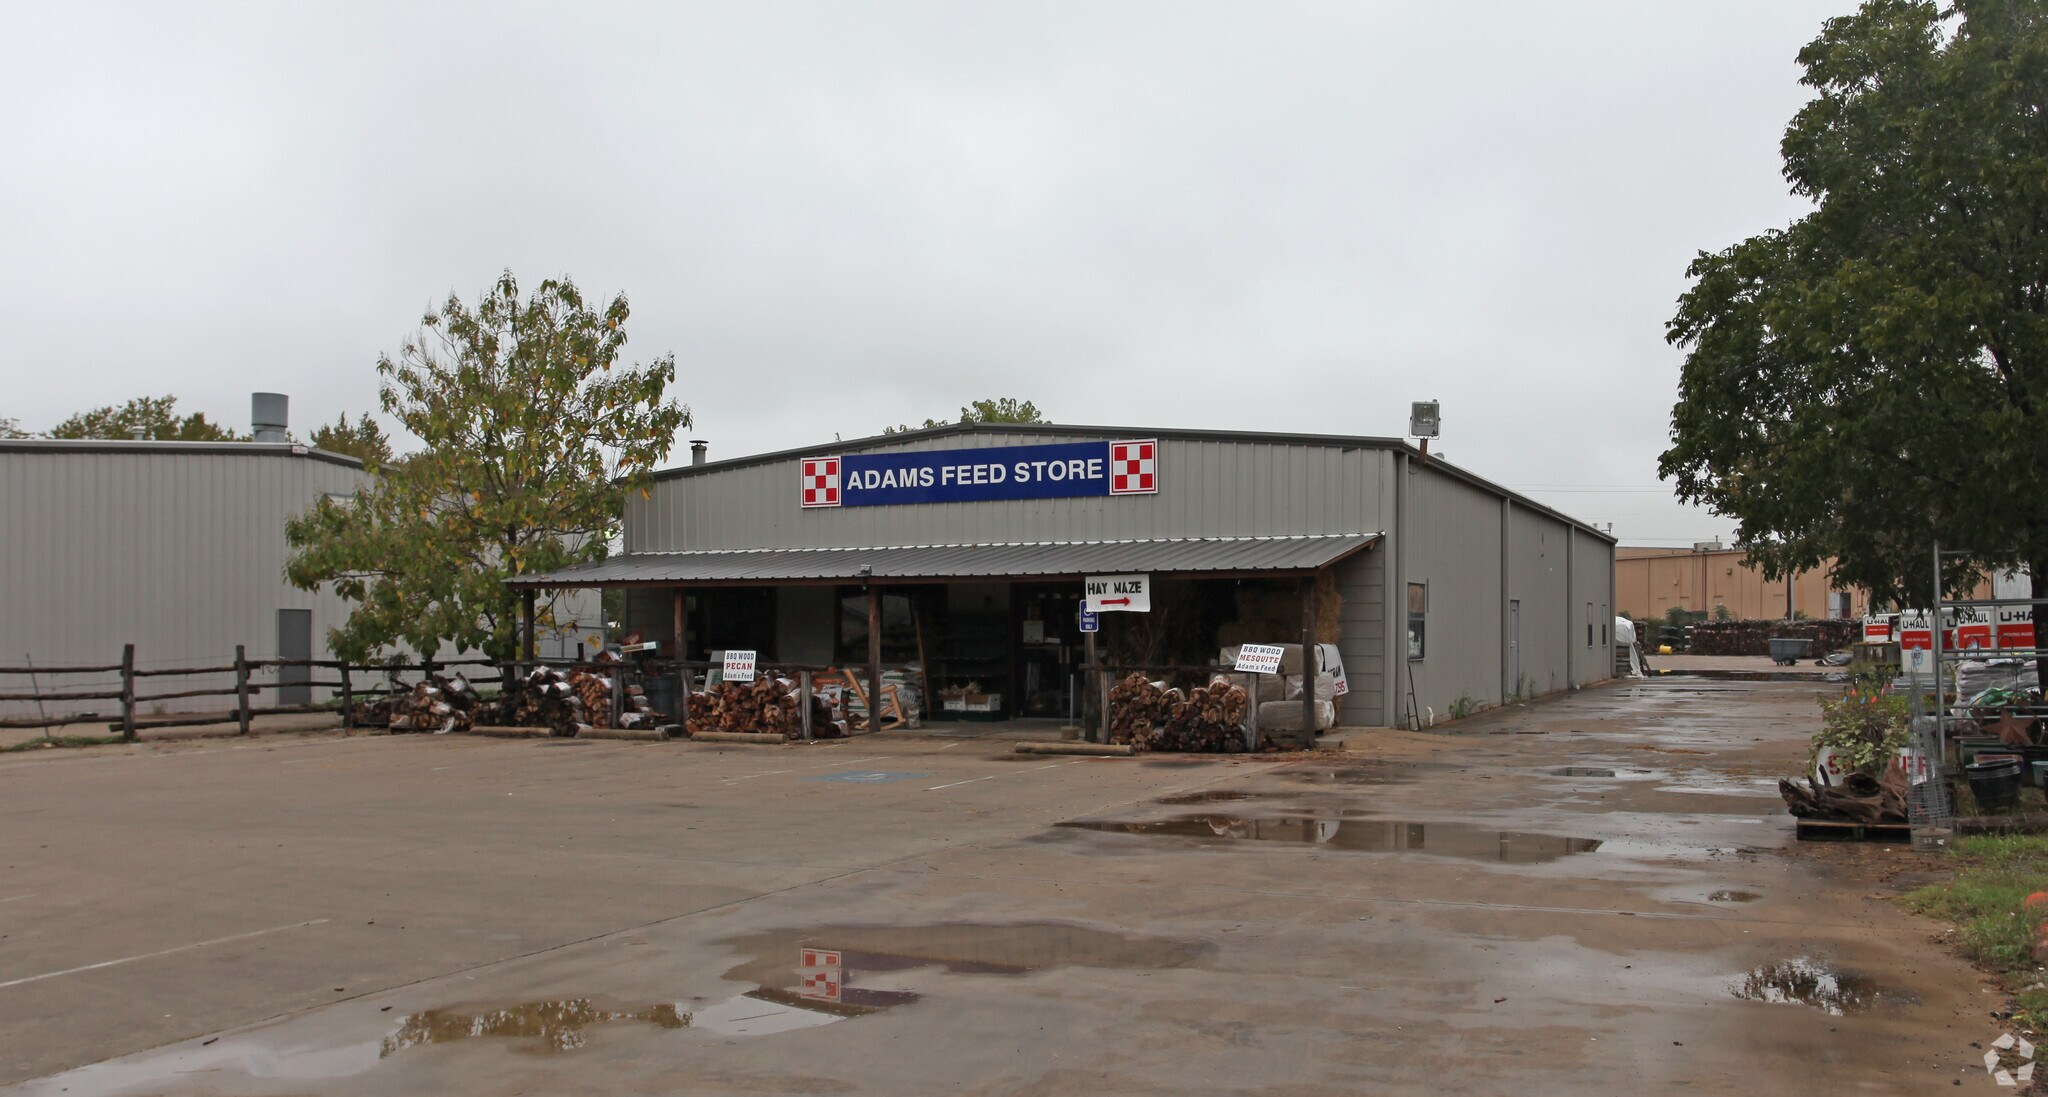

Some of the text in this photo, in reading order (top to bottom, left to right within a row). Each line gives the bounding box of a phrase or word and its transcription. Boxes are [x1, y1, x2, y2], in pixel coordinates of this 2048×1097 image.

[846, 458, 1103, 490] ADAMS FEED STORE
[1087, 581, 1142, 595] HAY MAZE
[2000, 610, 2033, 622] U-HA
[1902, 620, 1930, 629] U-HAUL
[1243, 645, 1281, 655] BBQ WOOD
[726, 652, 754, 660] BBQ WOOD
[1239, 654, 1280, 664] MESQUITE
[726, 662, 753, 670] PECAN
[1260, 664, 1276, 672] Feed
